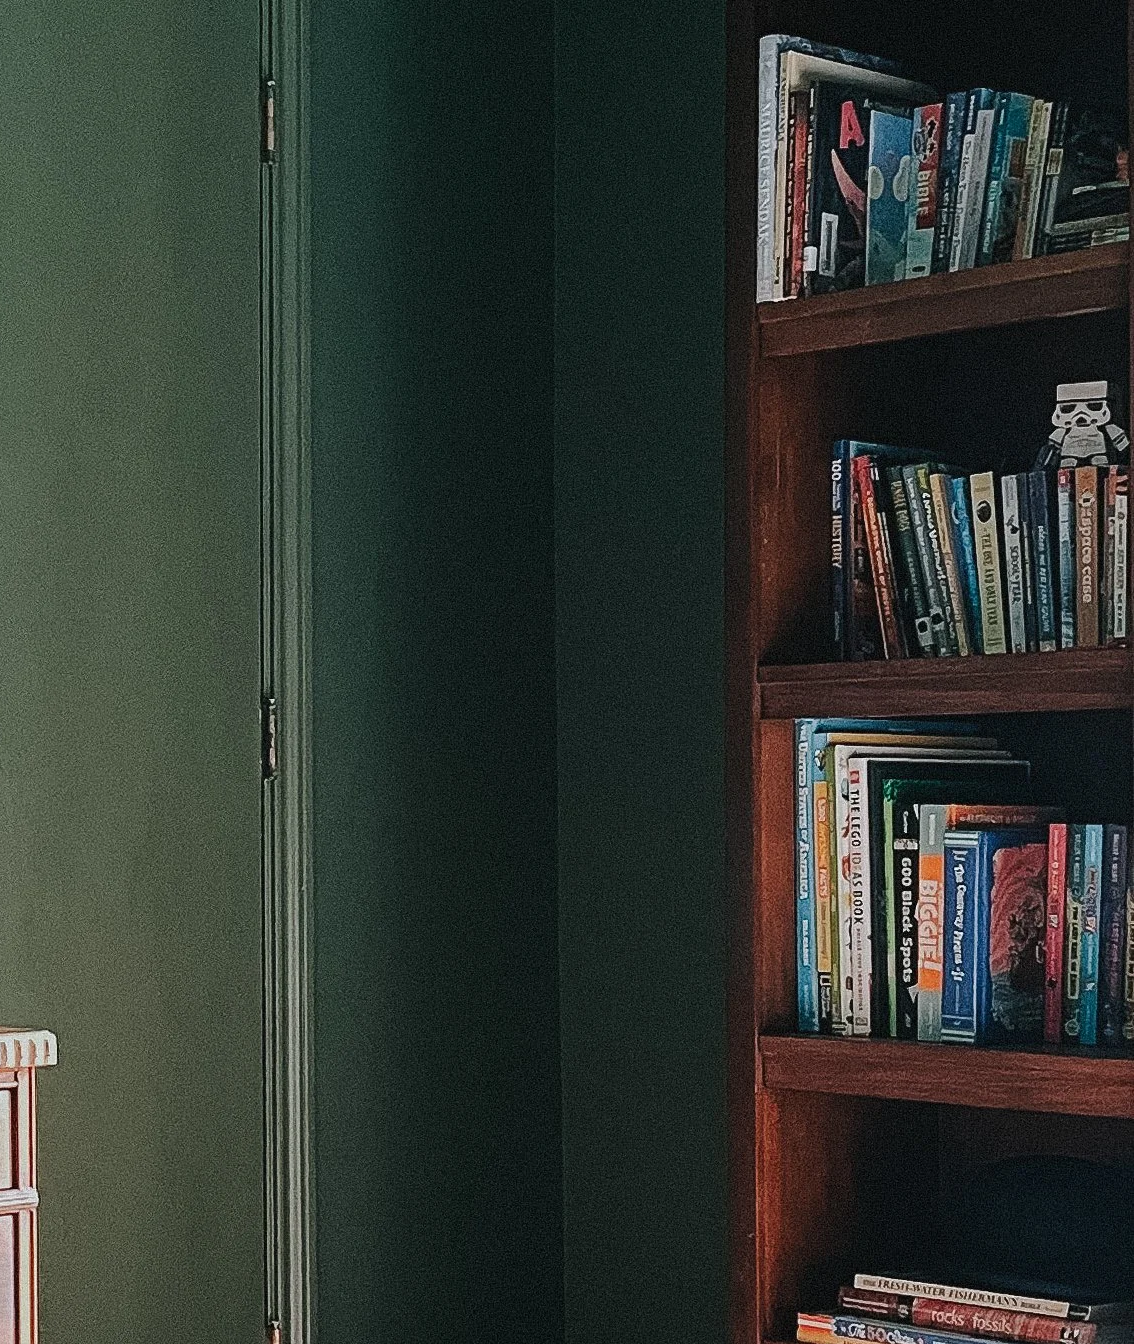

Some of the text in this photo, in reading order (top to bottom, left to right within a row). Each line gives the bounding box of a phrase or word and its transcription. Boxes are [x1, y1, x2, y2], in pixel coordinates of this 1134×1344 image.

[757, 101, 773, 246] MAURICE SENDAK
[916, 169, 932, 218] BIBLE
[830, 458, 842, 481] 100
[830, 514, 842, 568] HISTORY
[1078, 517, 1093, 603] space case
[796, 741, 809, 786] UNITED
[796, 786, 810, 829] STATES
[797, 840, 811, 900] AMERICA
[849, 788, 865, 925] THE LEGO IDEAS BOOK
[818, 868, 829, 897] FACTS
[901, 890, 914, 933] Black
[918, 879, 942, 972] BIGGIE!
[899, 936, 914, 984] Spots
[931, 1308, 1013, 1334] rocks fossils
[948, 1288, 1019, 1308] FISHERMAN'S
[847, 1323, 867, 1340] The
[866, 1326, 886, 1343] 50
